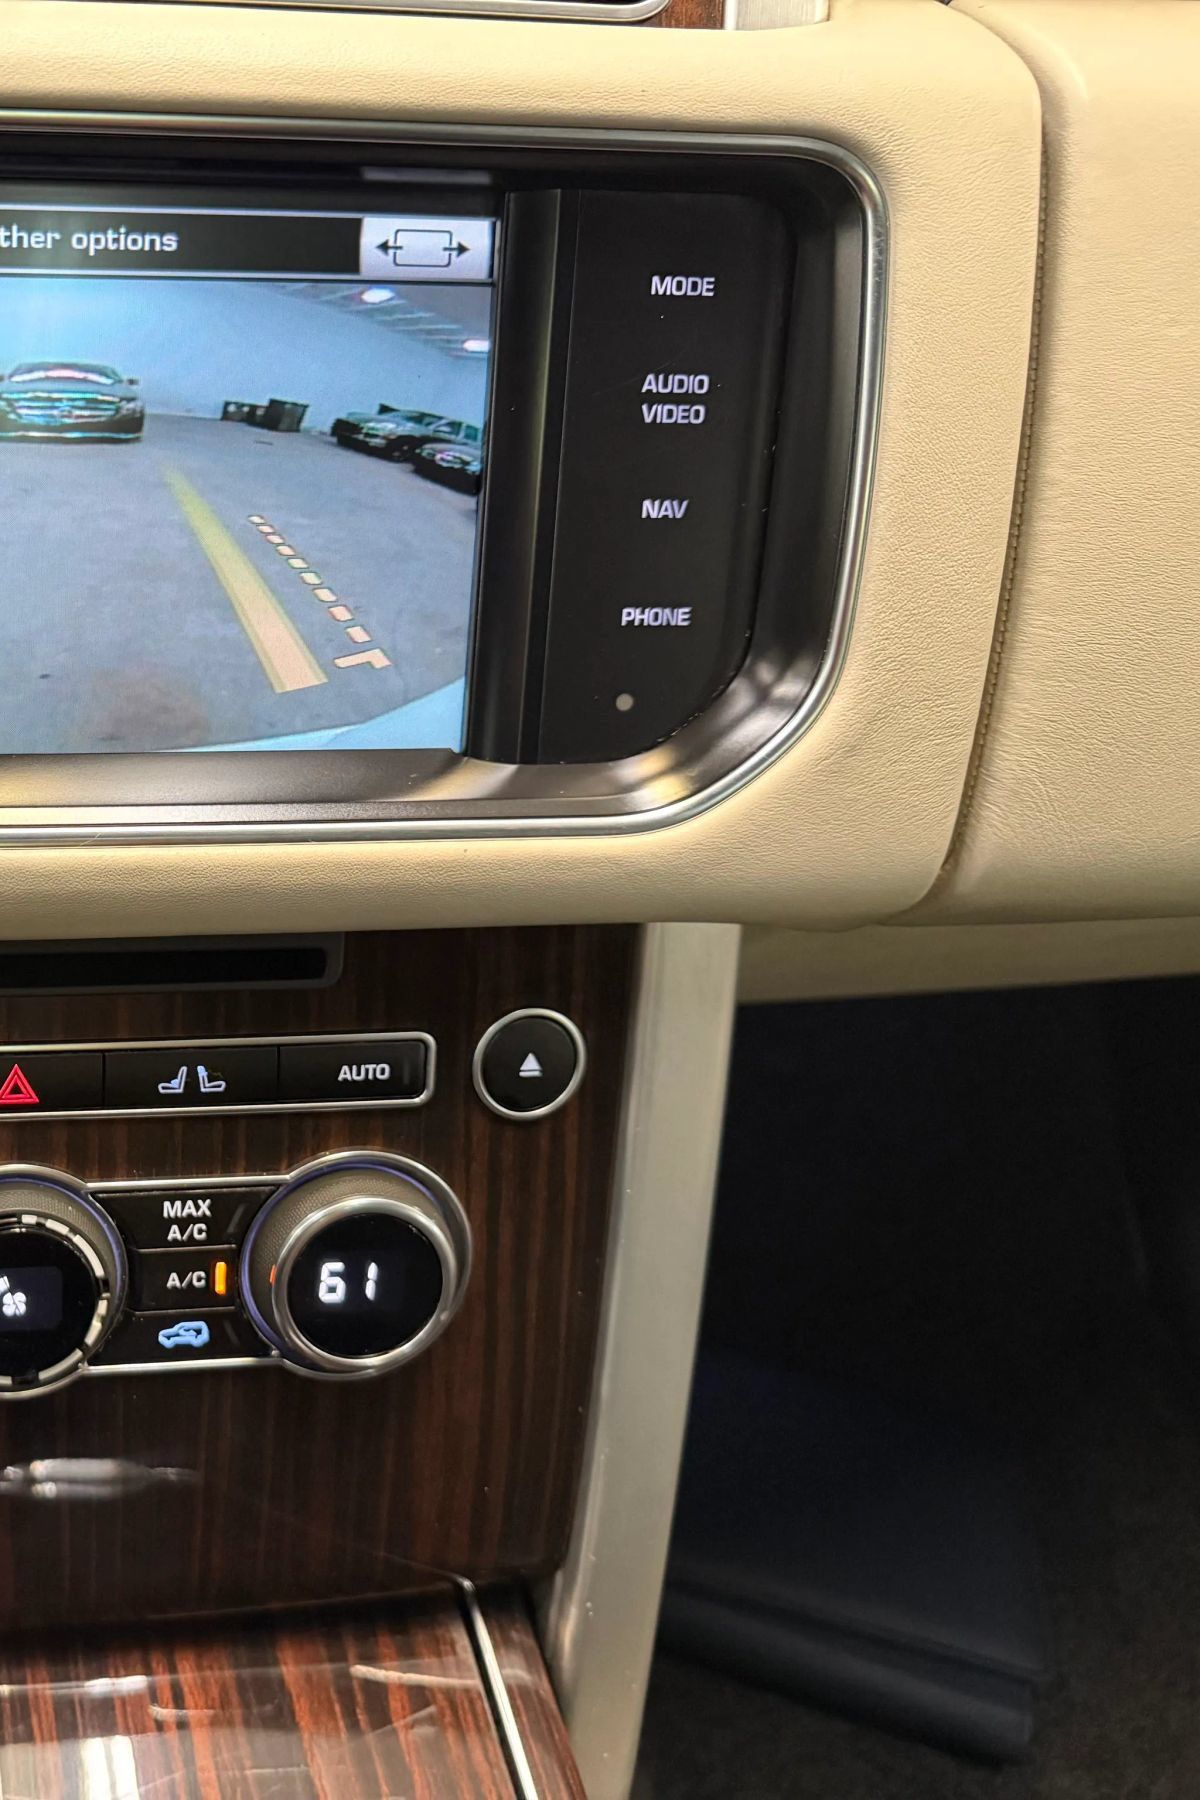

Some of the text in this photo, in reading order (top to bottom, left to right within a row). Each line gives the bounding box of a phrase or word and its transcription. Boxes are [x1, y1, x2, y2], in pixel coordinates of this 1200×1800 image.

[70, 225, 179, 256] options
[650, 275, 716, 298] MODE
[641, 373, 710, 394] AUDIO
[641, 403, 706, 425] VIDEO
[641, 498, 690, 519] NAV
[620, 606, 692, 627] PHONE
[337, 1063, 391, 1082] AUTO
[162, 1198, 212, 1219] MAX
[167, 1223, 207, 1242] A/C
[166, 1270, 206, 1289] A/C
[318, 1261, 379, 1304] 61
